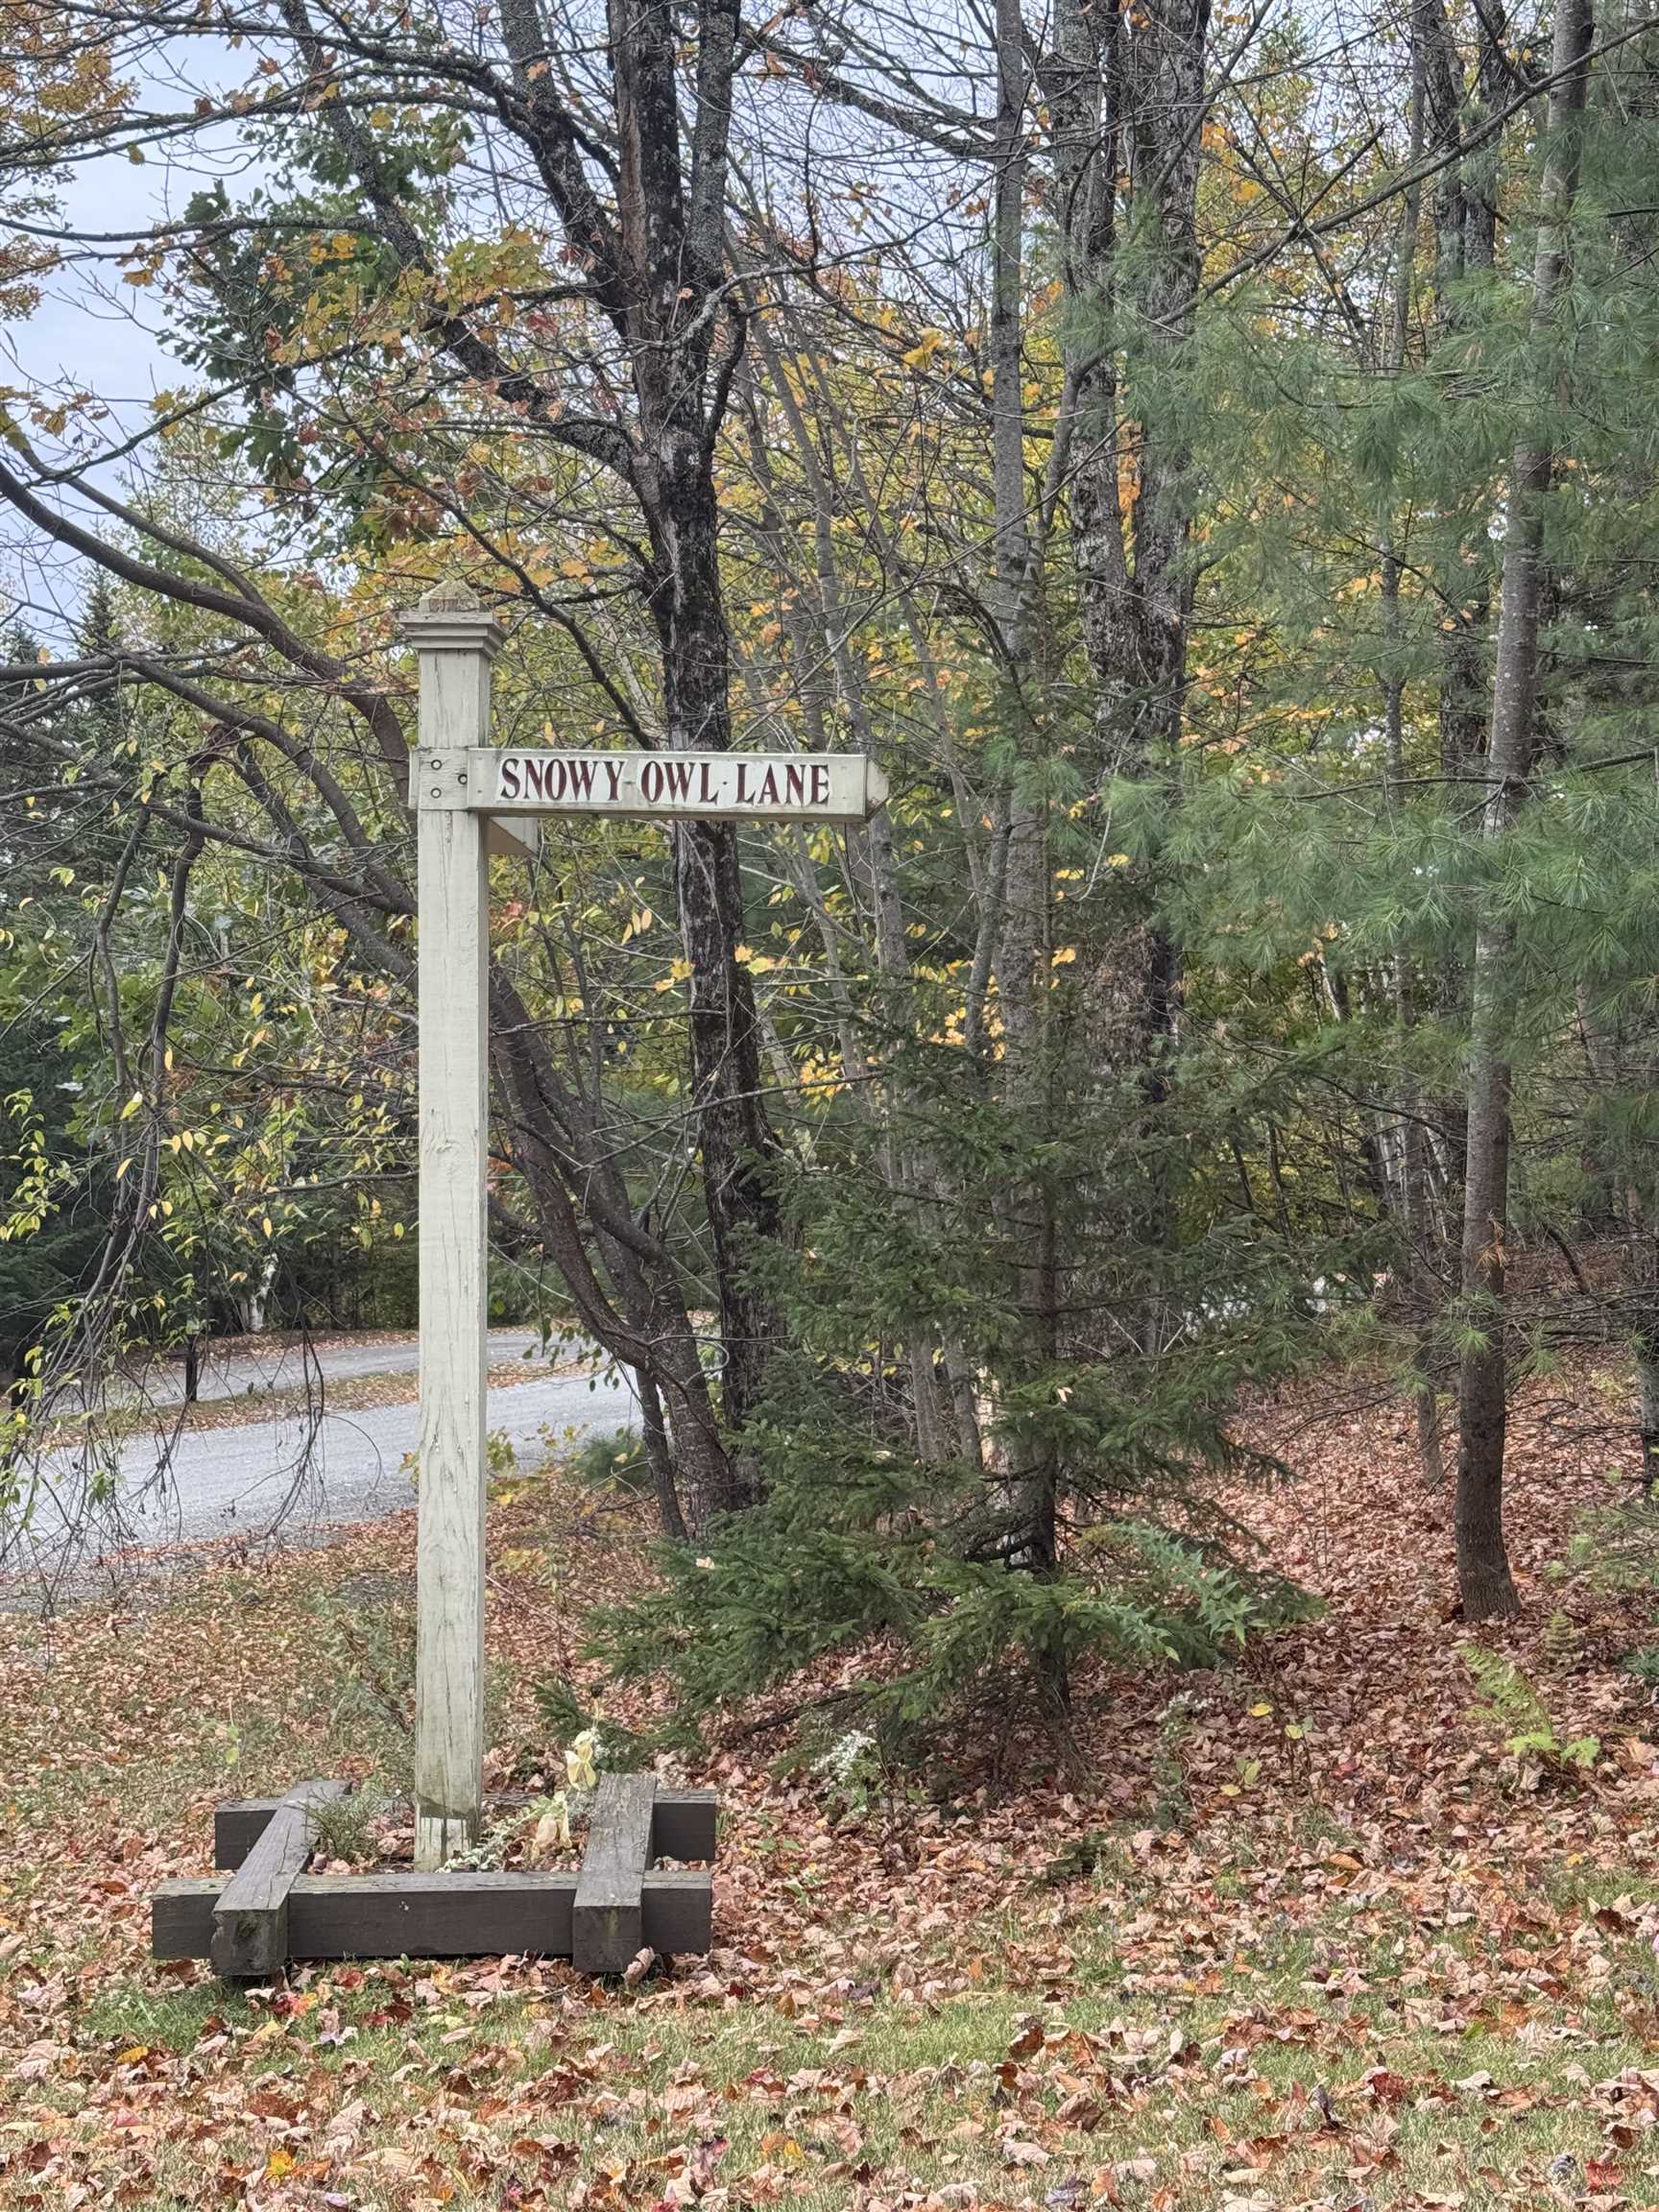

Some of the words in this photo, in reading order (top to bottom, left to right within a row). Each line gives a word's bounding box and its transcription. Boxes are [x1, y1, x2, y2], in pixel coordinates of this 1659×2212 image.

[500, 757, 625, 802] SNOWY
[640, 760, 719, 804] OWL
[735, 763, 830, 805] LANE
